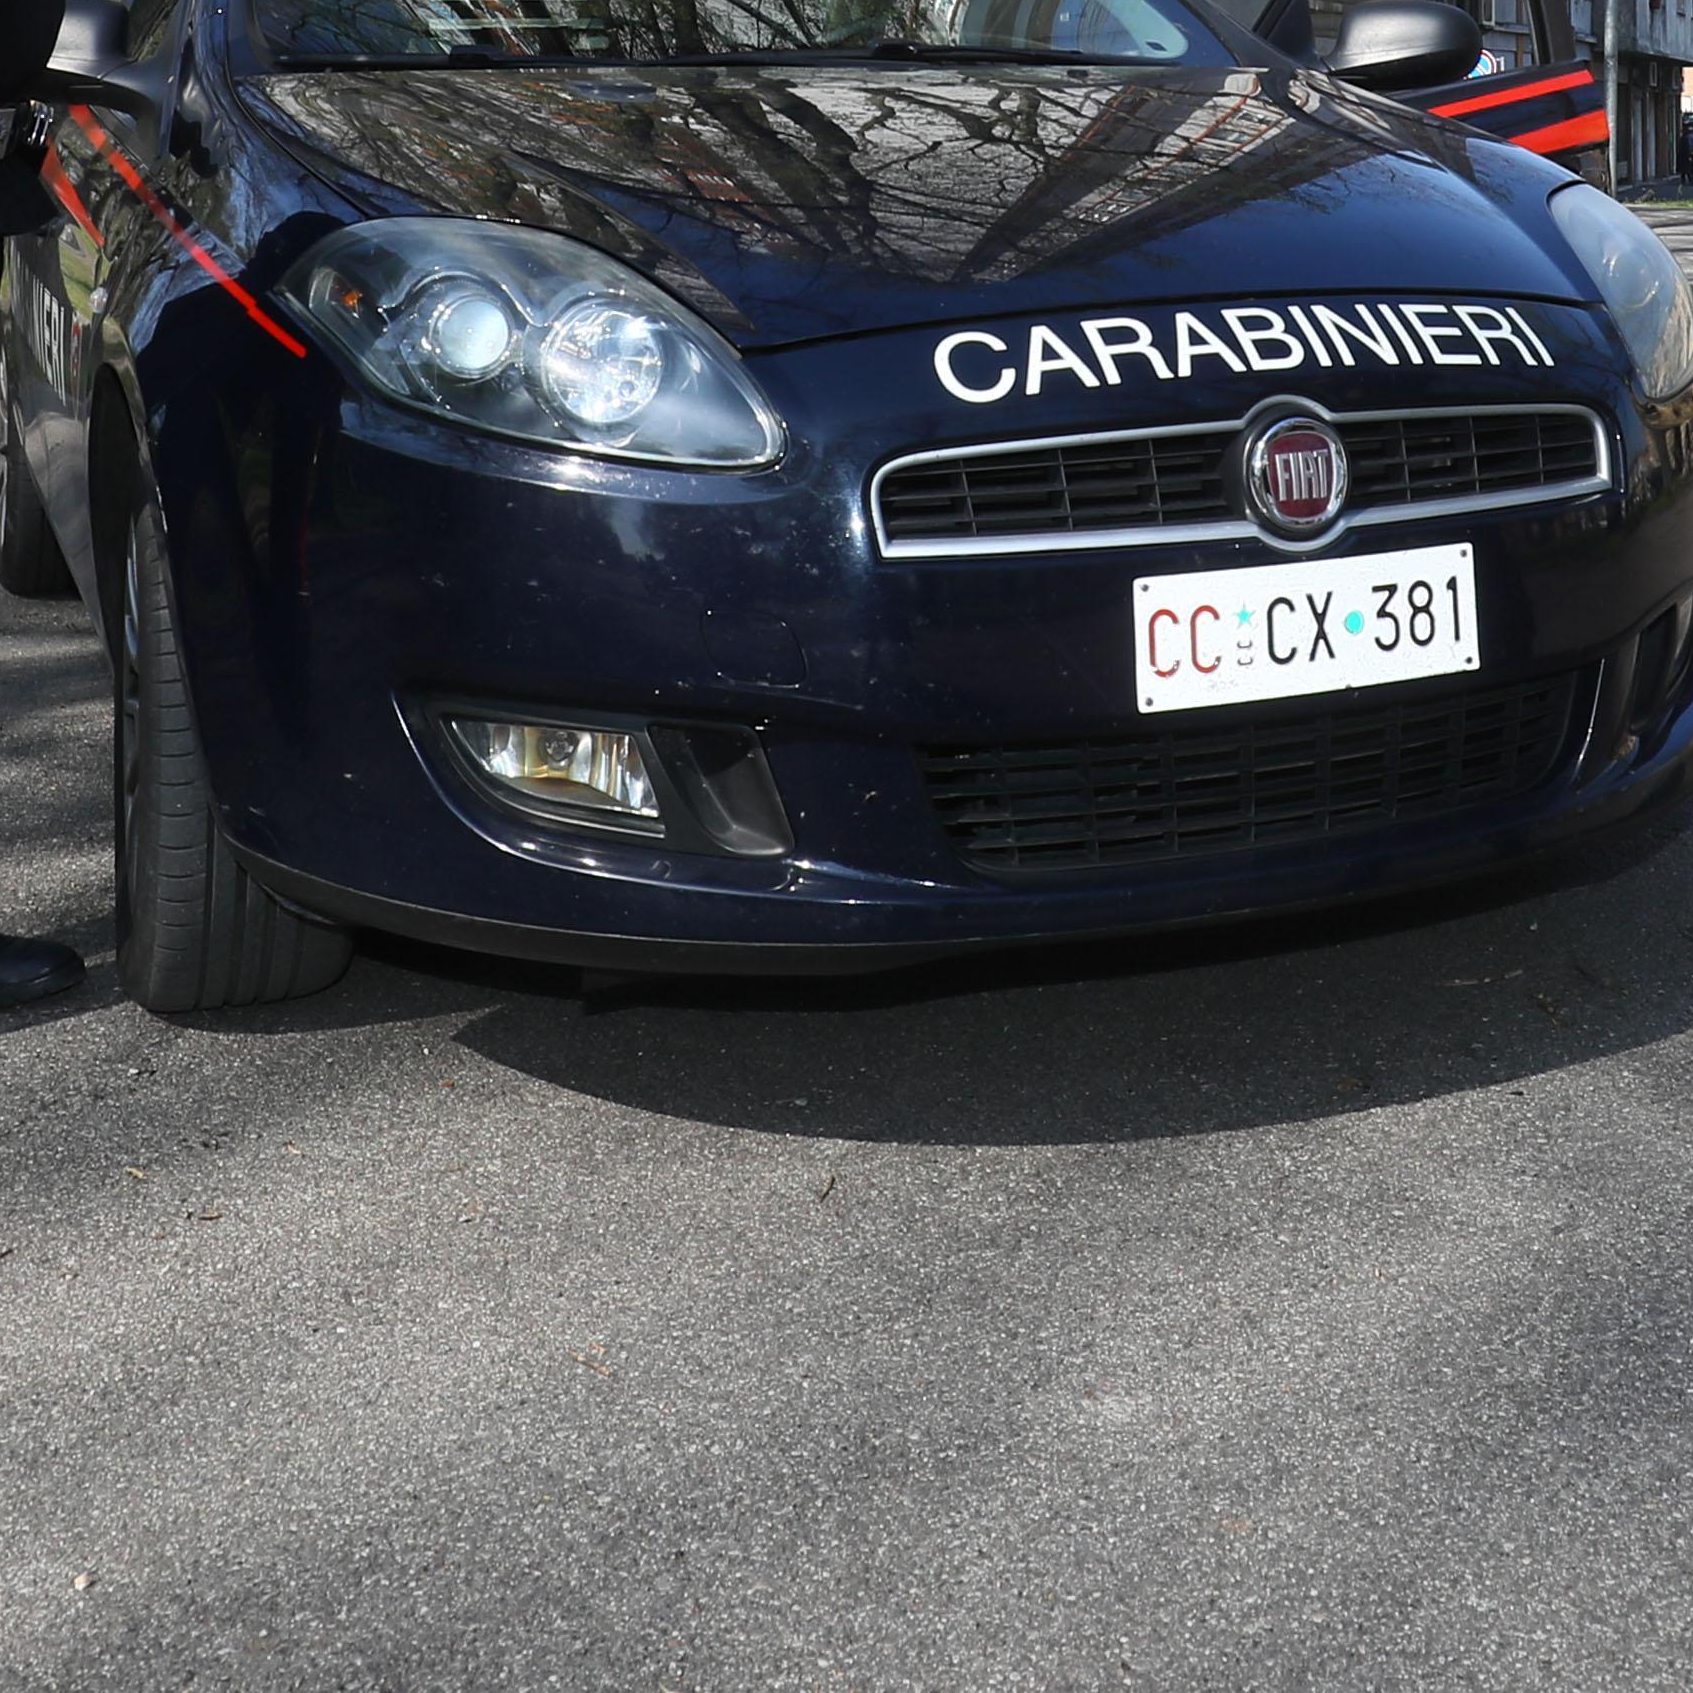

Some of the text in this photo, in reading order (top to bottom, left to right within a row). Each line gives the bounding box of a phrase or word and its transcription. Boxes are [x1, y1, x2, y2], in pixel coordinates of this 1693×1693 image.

[934, 304, 1555, 403] CARABINIERI
[1275, 449, 1328, 501] FIAT
[1149, 576, 1461, 678] CC CX 381
